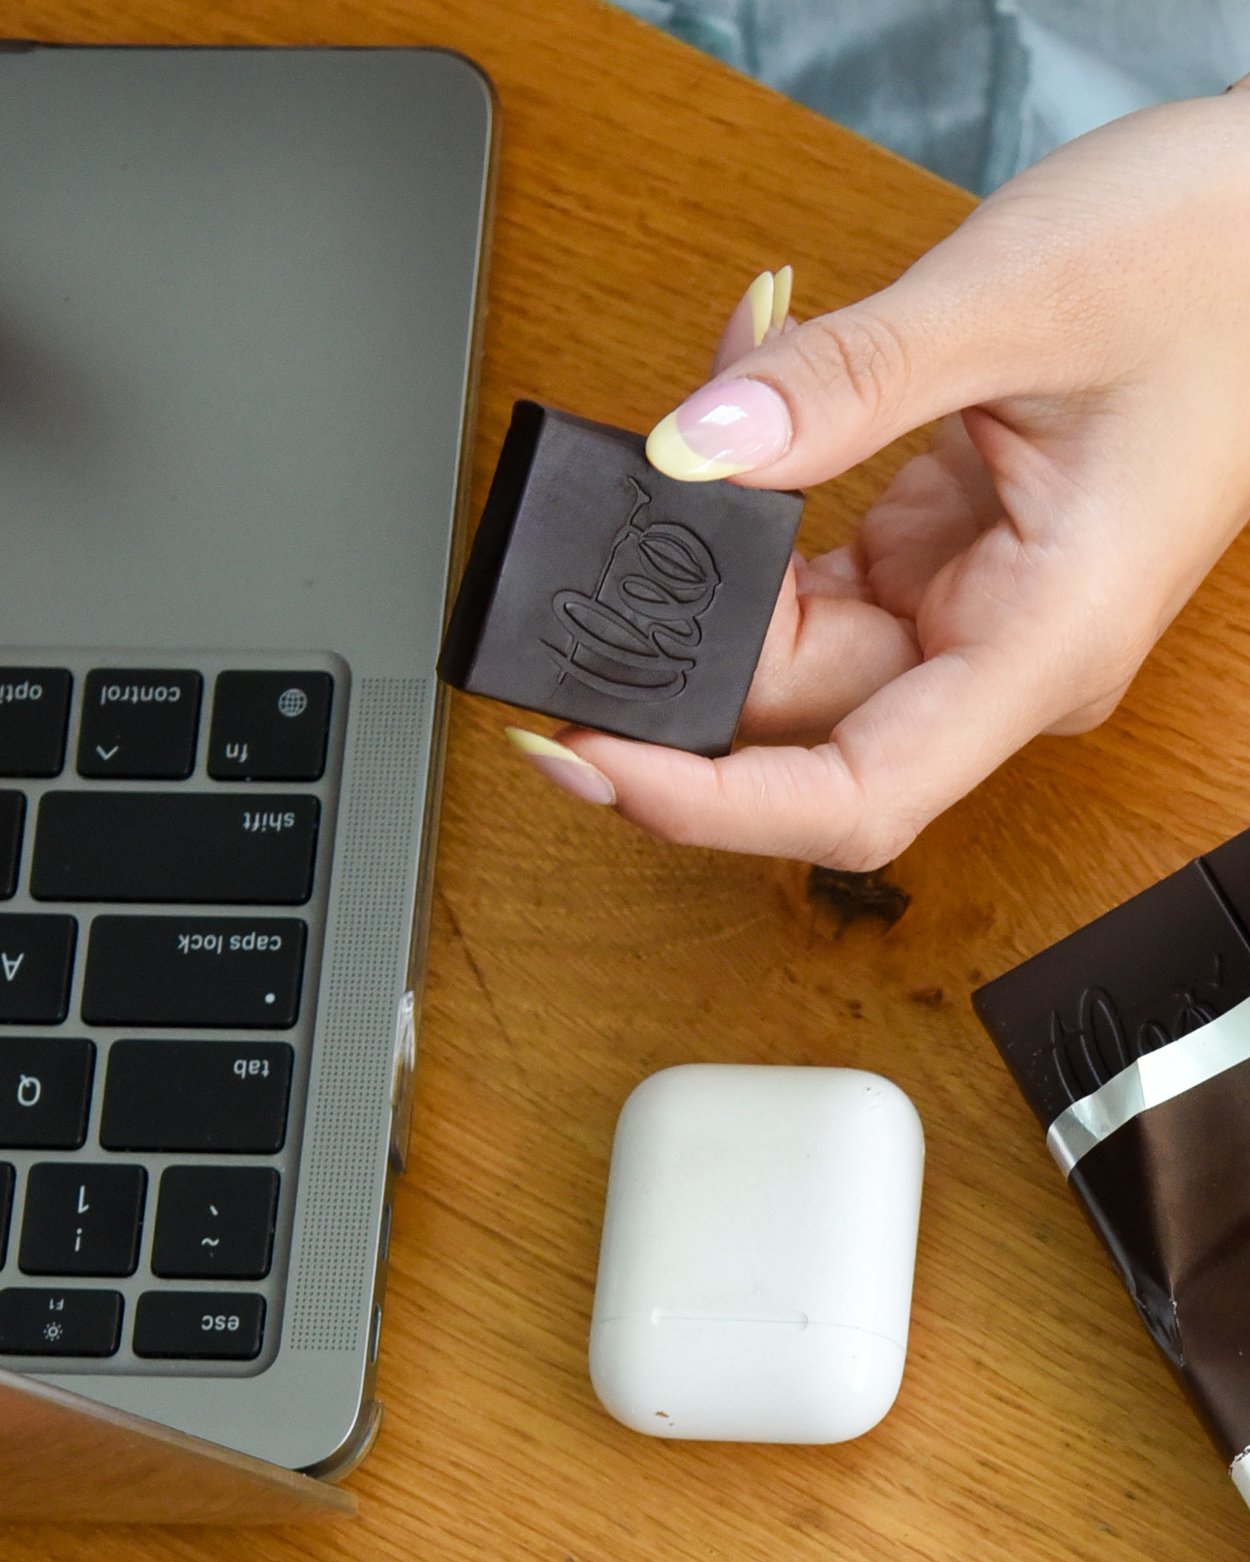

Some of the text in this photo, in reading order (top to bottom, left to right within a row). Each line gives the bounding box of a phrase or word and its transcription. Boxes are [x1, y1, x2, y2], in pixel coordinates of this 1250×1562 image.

[100, 684, 181, 706] control
[225, 743, 248, 763] fn
[243, 811, 295, 832] shift
[177, 932, 282, 954] caps lock
[1, 952, 24, 981] A
[233, 1059, 270, 1079] tab
[17, 1074, 42, 1106] Q
[77, 1184, 90, 1214] 1
[49, 1298, 64, 1311] F1
[201, 1315, 240, 1331] esc
